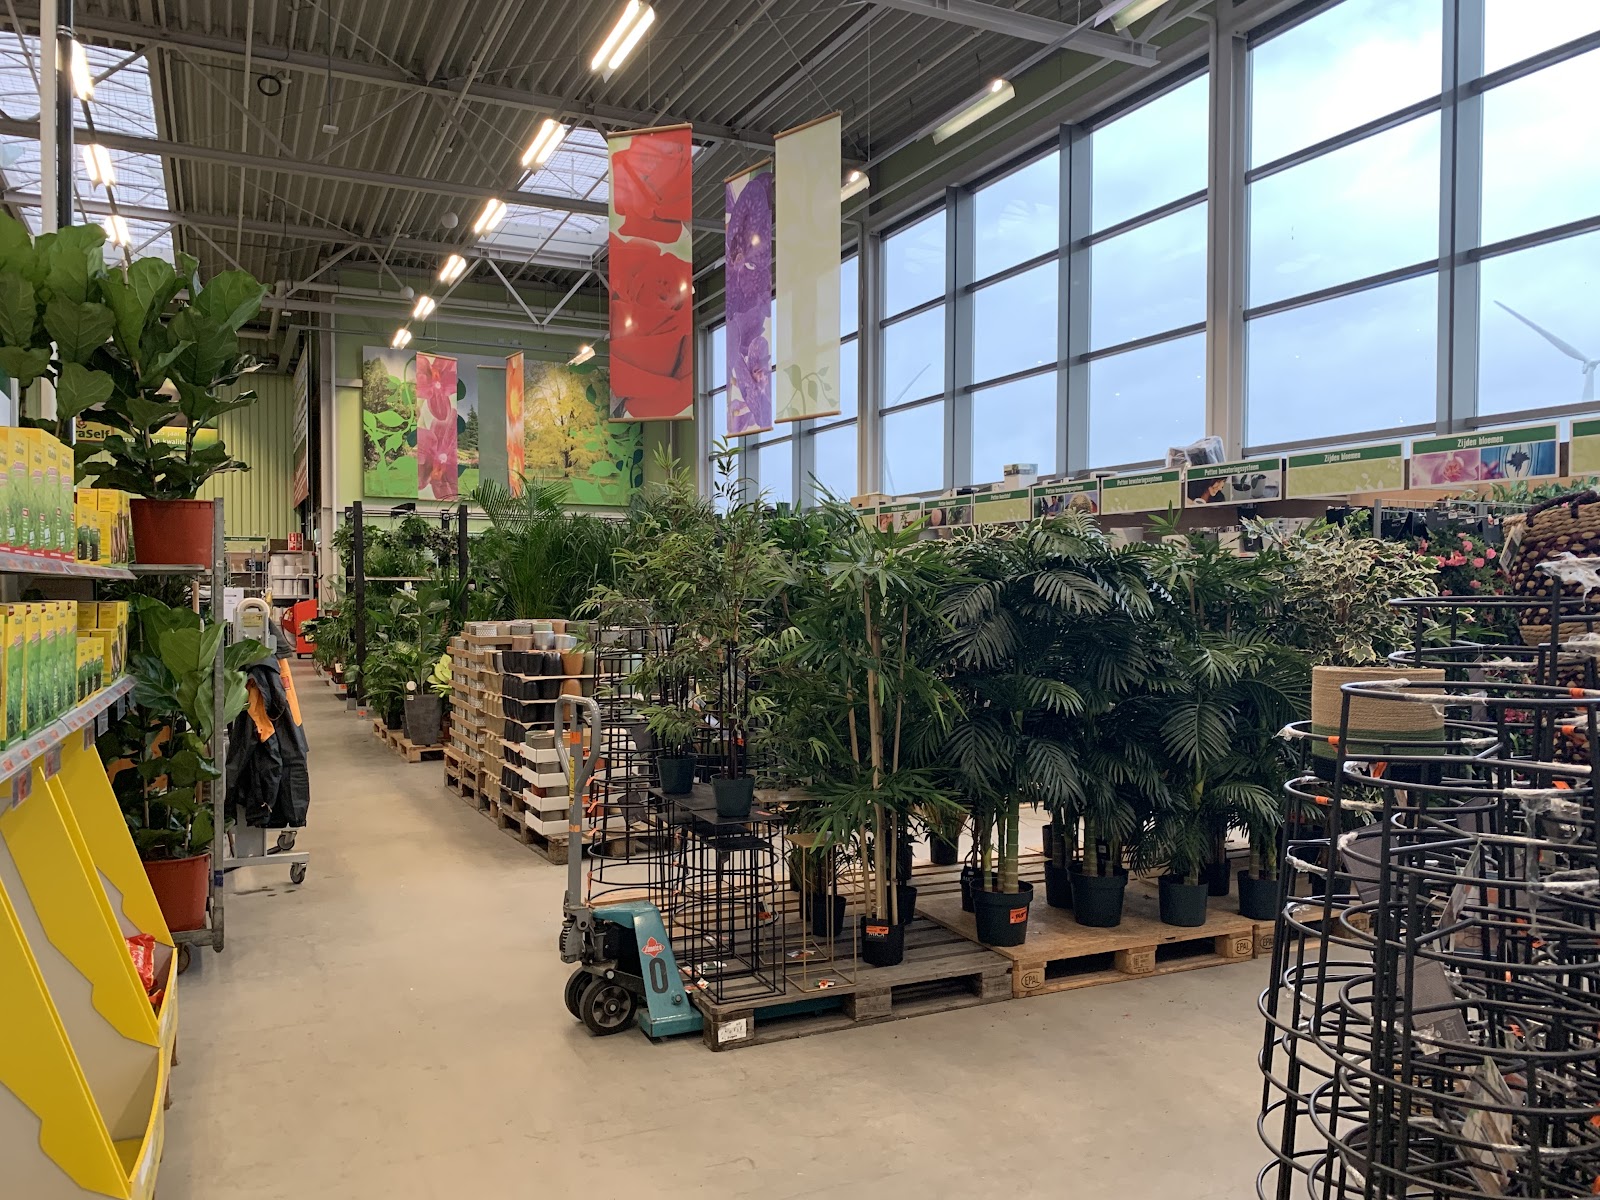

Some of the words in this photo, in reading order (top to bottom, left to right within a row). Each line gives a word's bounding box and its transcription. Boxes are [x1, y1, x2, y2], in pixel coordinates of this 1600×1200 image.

[76, 429, 110, 439] aSelf
[1457, 438, 1476, 449] Zijden
[1478, 435, 1504, 446] bloemen
[1324, 453, 1340, 463] Zijden
[1340, 451, 1361, 460] bloemen
[1204, 468, 1218, 476] Potten
[1237, 942, 1250, 952] EPAL
[649, 958, 669, 993] 0
[1024, 975, 1041, 986] EPAL
